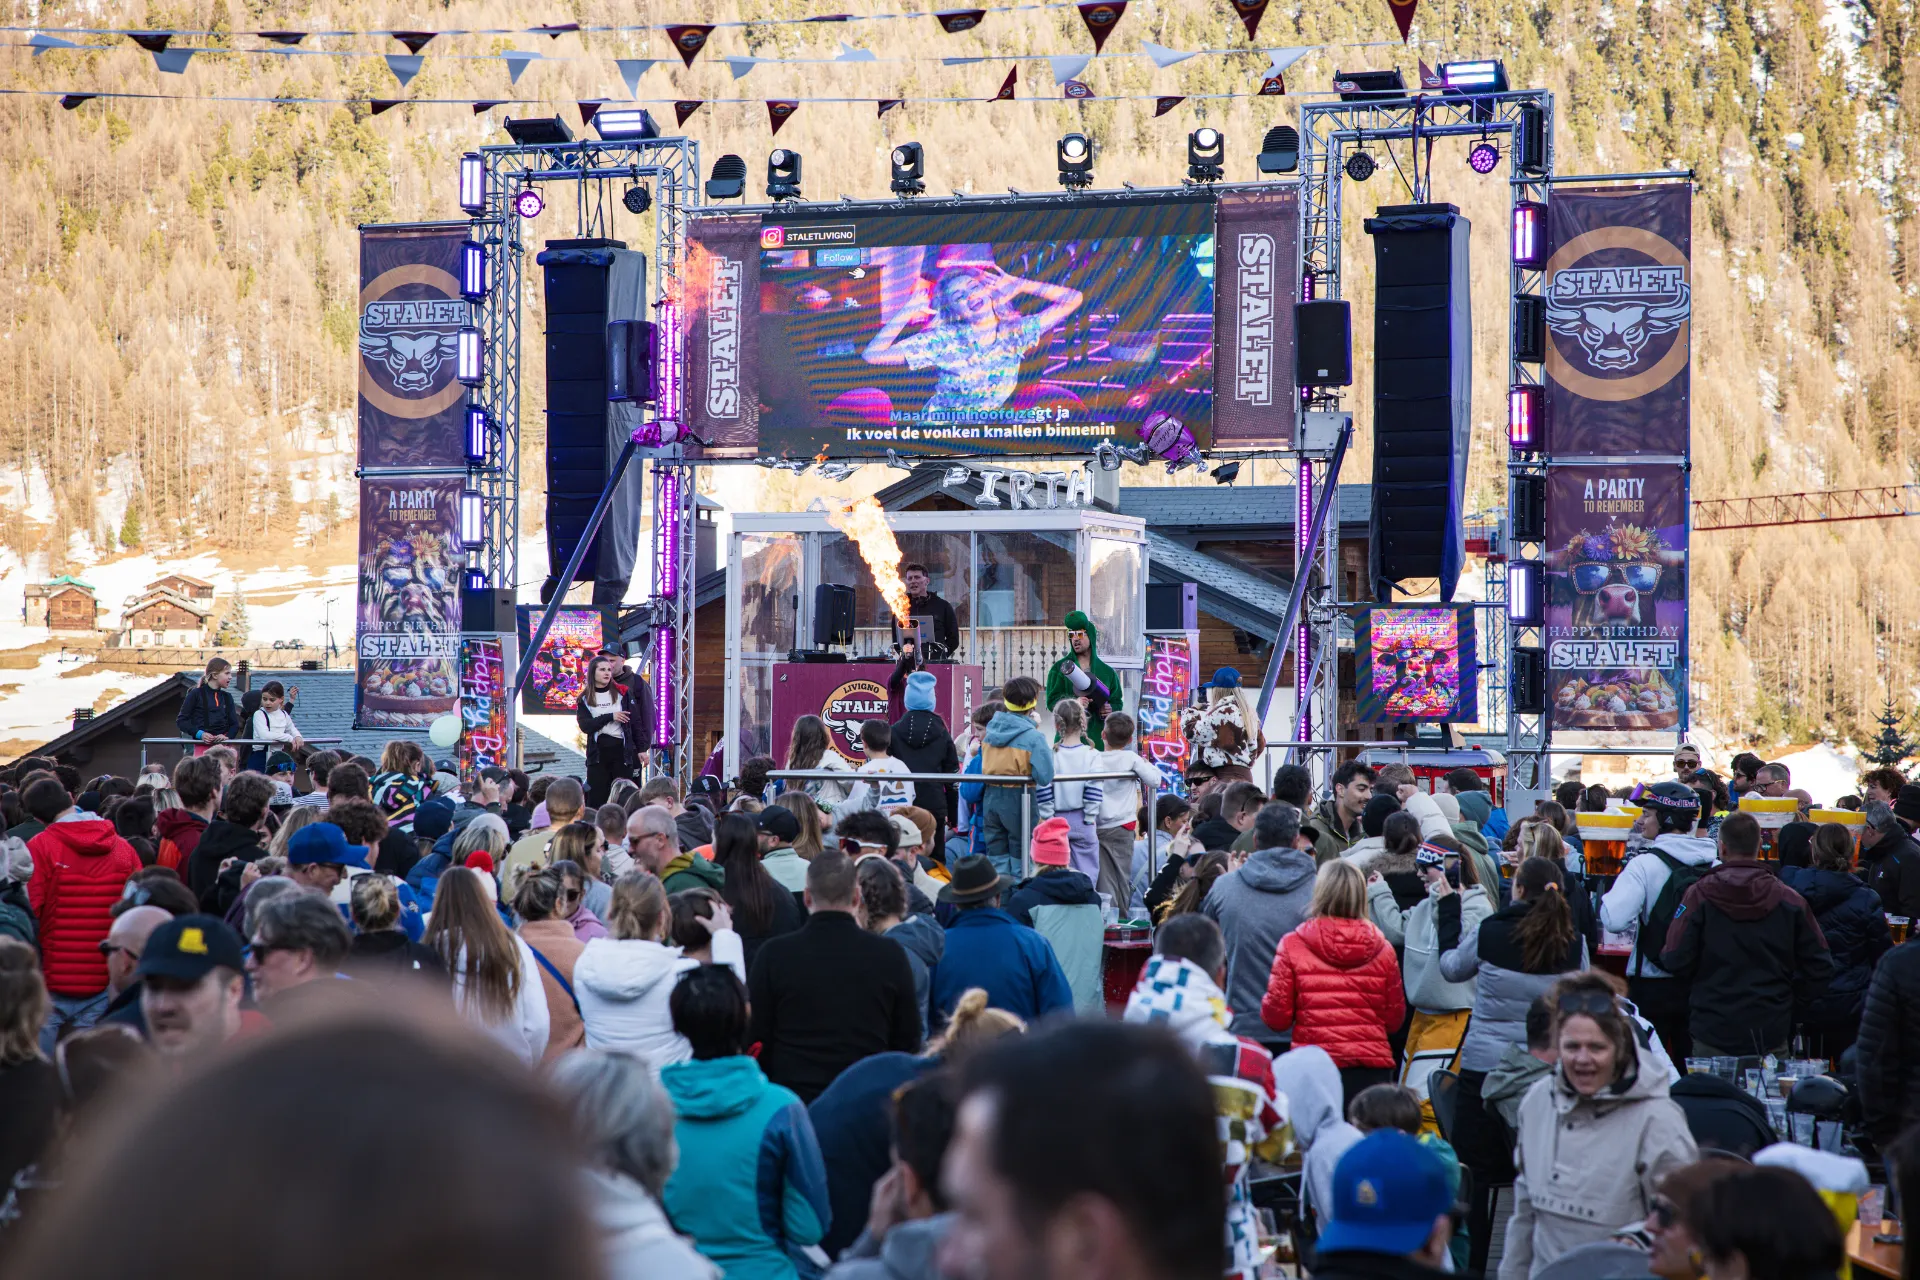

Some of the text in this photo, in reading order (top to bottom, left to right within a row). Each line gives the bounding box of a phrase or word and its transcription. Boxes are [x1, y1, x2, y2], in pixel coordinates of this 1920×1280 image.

[786, 231, 853, 241] STALETLIVIGNO
[823, 254, 853, 262] Follow
[1554, 266, 1684, 298] STALET
[365, 300, 467, 328] STALET
[1236, 234, 1275, 405] STALET
[706, 256, 742, 418] STALET
[890, 405, 1070, 424] Maar mijn hoofd zegt ja
[846, 422, 1116, 440] Ik voel de vonken knallen binnenin
[1583, 478, 1645, 499] A PARTY
[388, 490, 436, 509] A PARTY
[1583, 500, 1645, 513] TO REMEMBER
[388, 509, 437, 521] TO REMEMBER
[360, 620, 462, 631] HAPPY BIRTHDAY
[1379, 623, 1449, 638] STALET
[1549, 626, 1680, 637] HAPPY BIRTHDAY
[360, 633, 460, 659] STALET
[1549, 640, 1679, 669] STALET
[462, 640, 501, 728] Happy
[843, 682, 880, 694] LIVIGNO
[1139, 638, 1189, 732] Happy
[1663, 796, 1683, 808] Red
